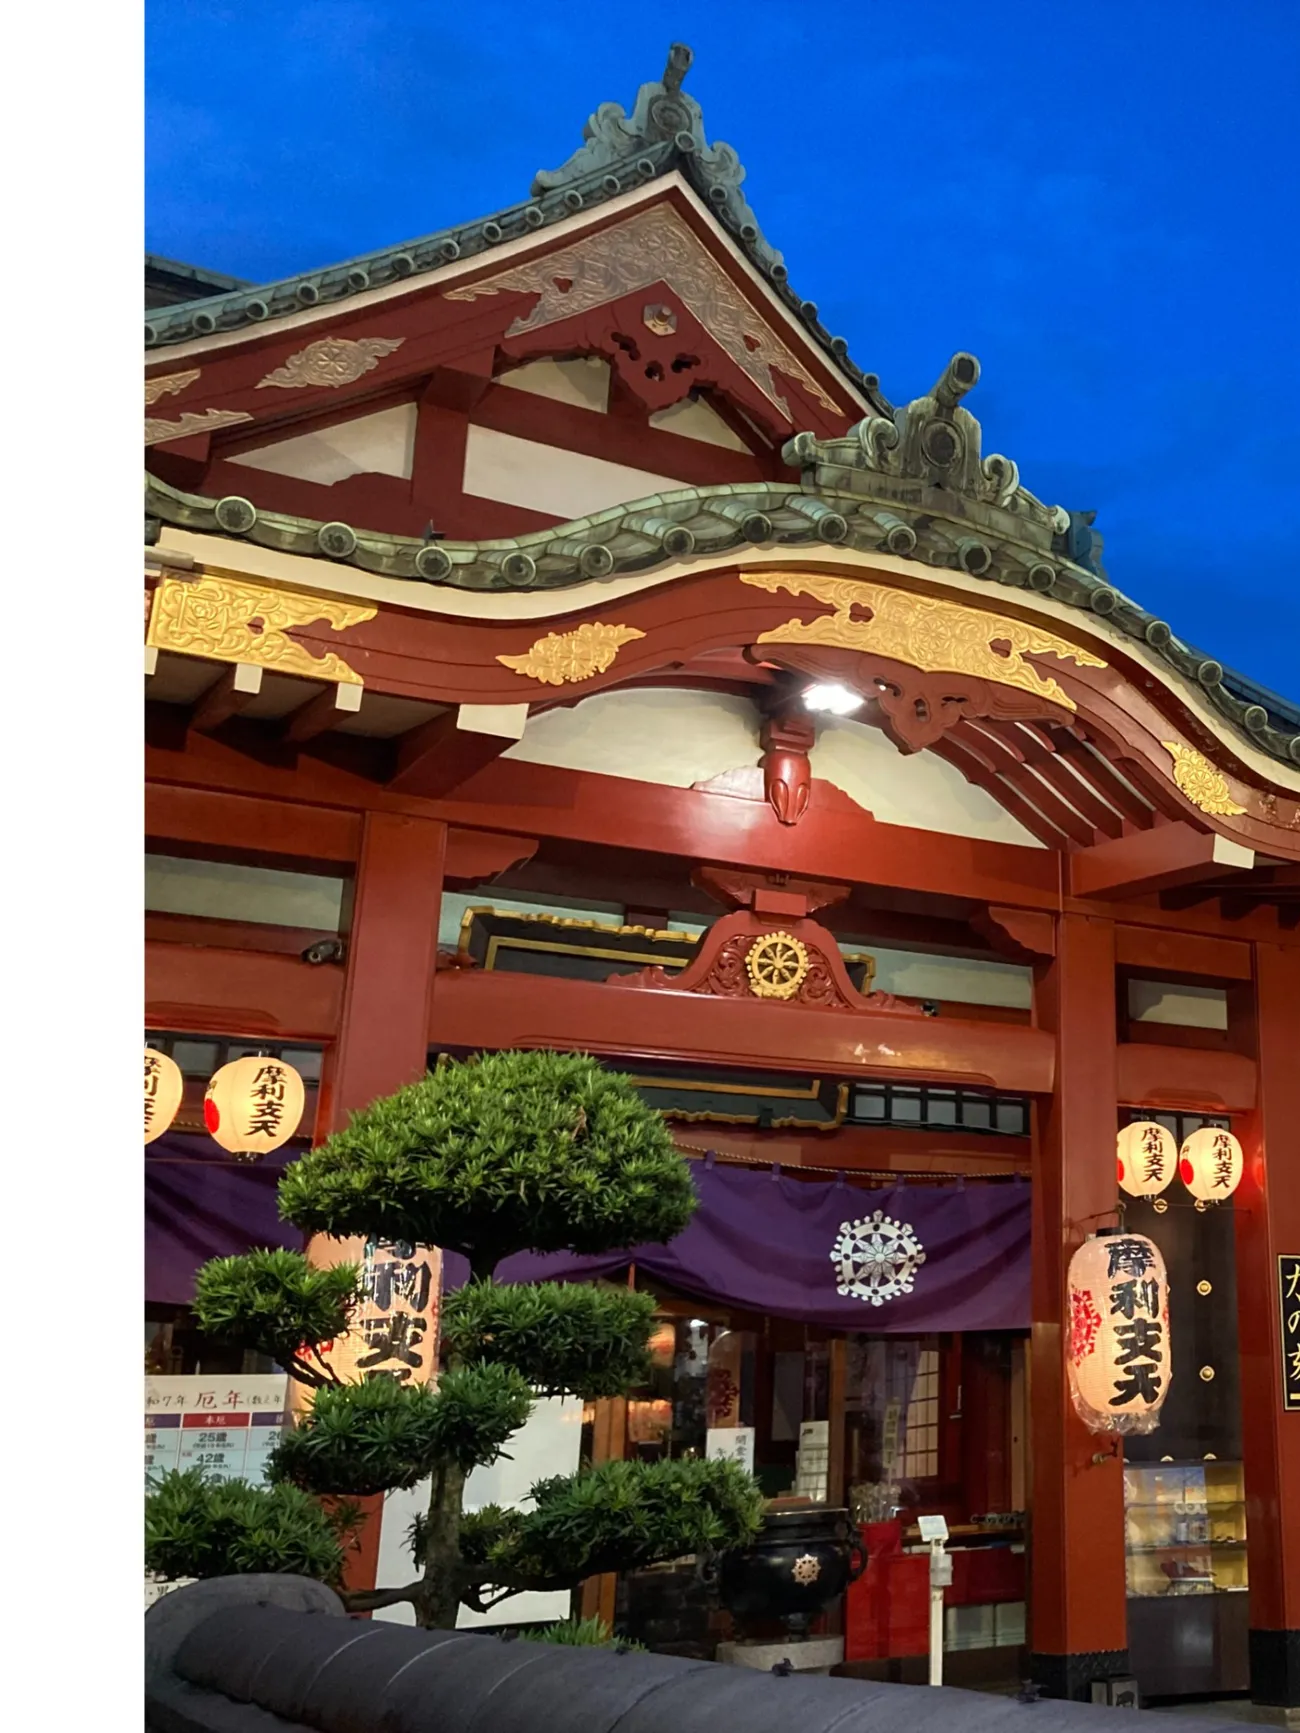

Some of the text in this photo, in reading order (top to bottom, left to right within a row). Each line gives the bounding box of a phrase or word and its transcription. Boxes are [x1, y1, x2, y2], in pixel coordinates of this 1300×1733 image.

[244, 1064, 288, 1138] 摩利支天
[1141, 1127, 1165, 1183] 摩利支天
[1211, 1134, 1233, 1189] 摩利支天
[1104, 1238, 1163, 1407] 摩利支天
